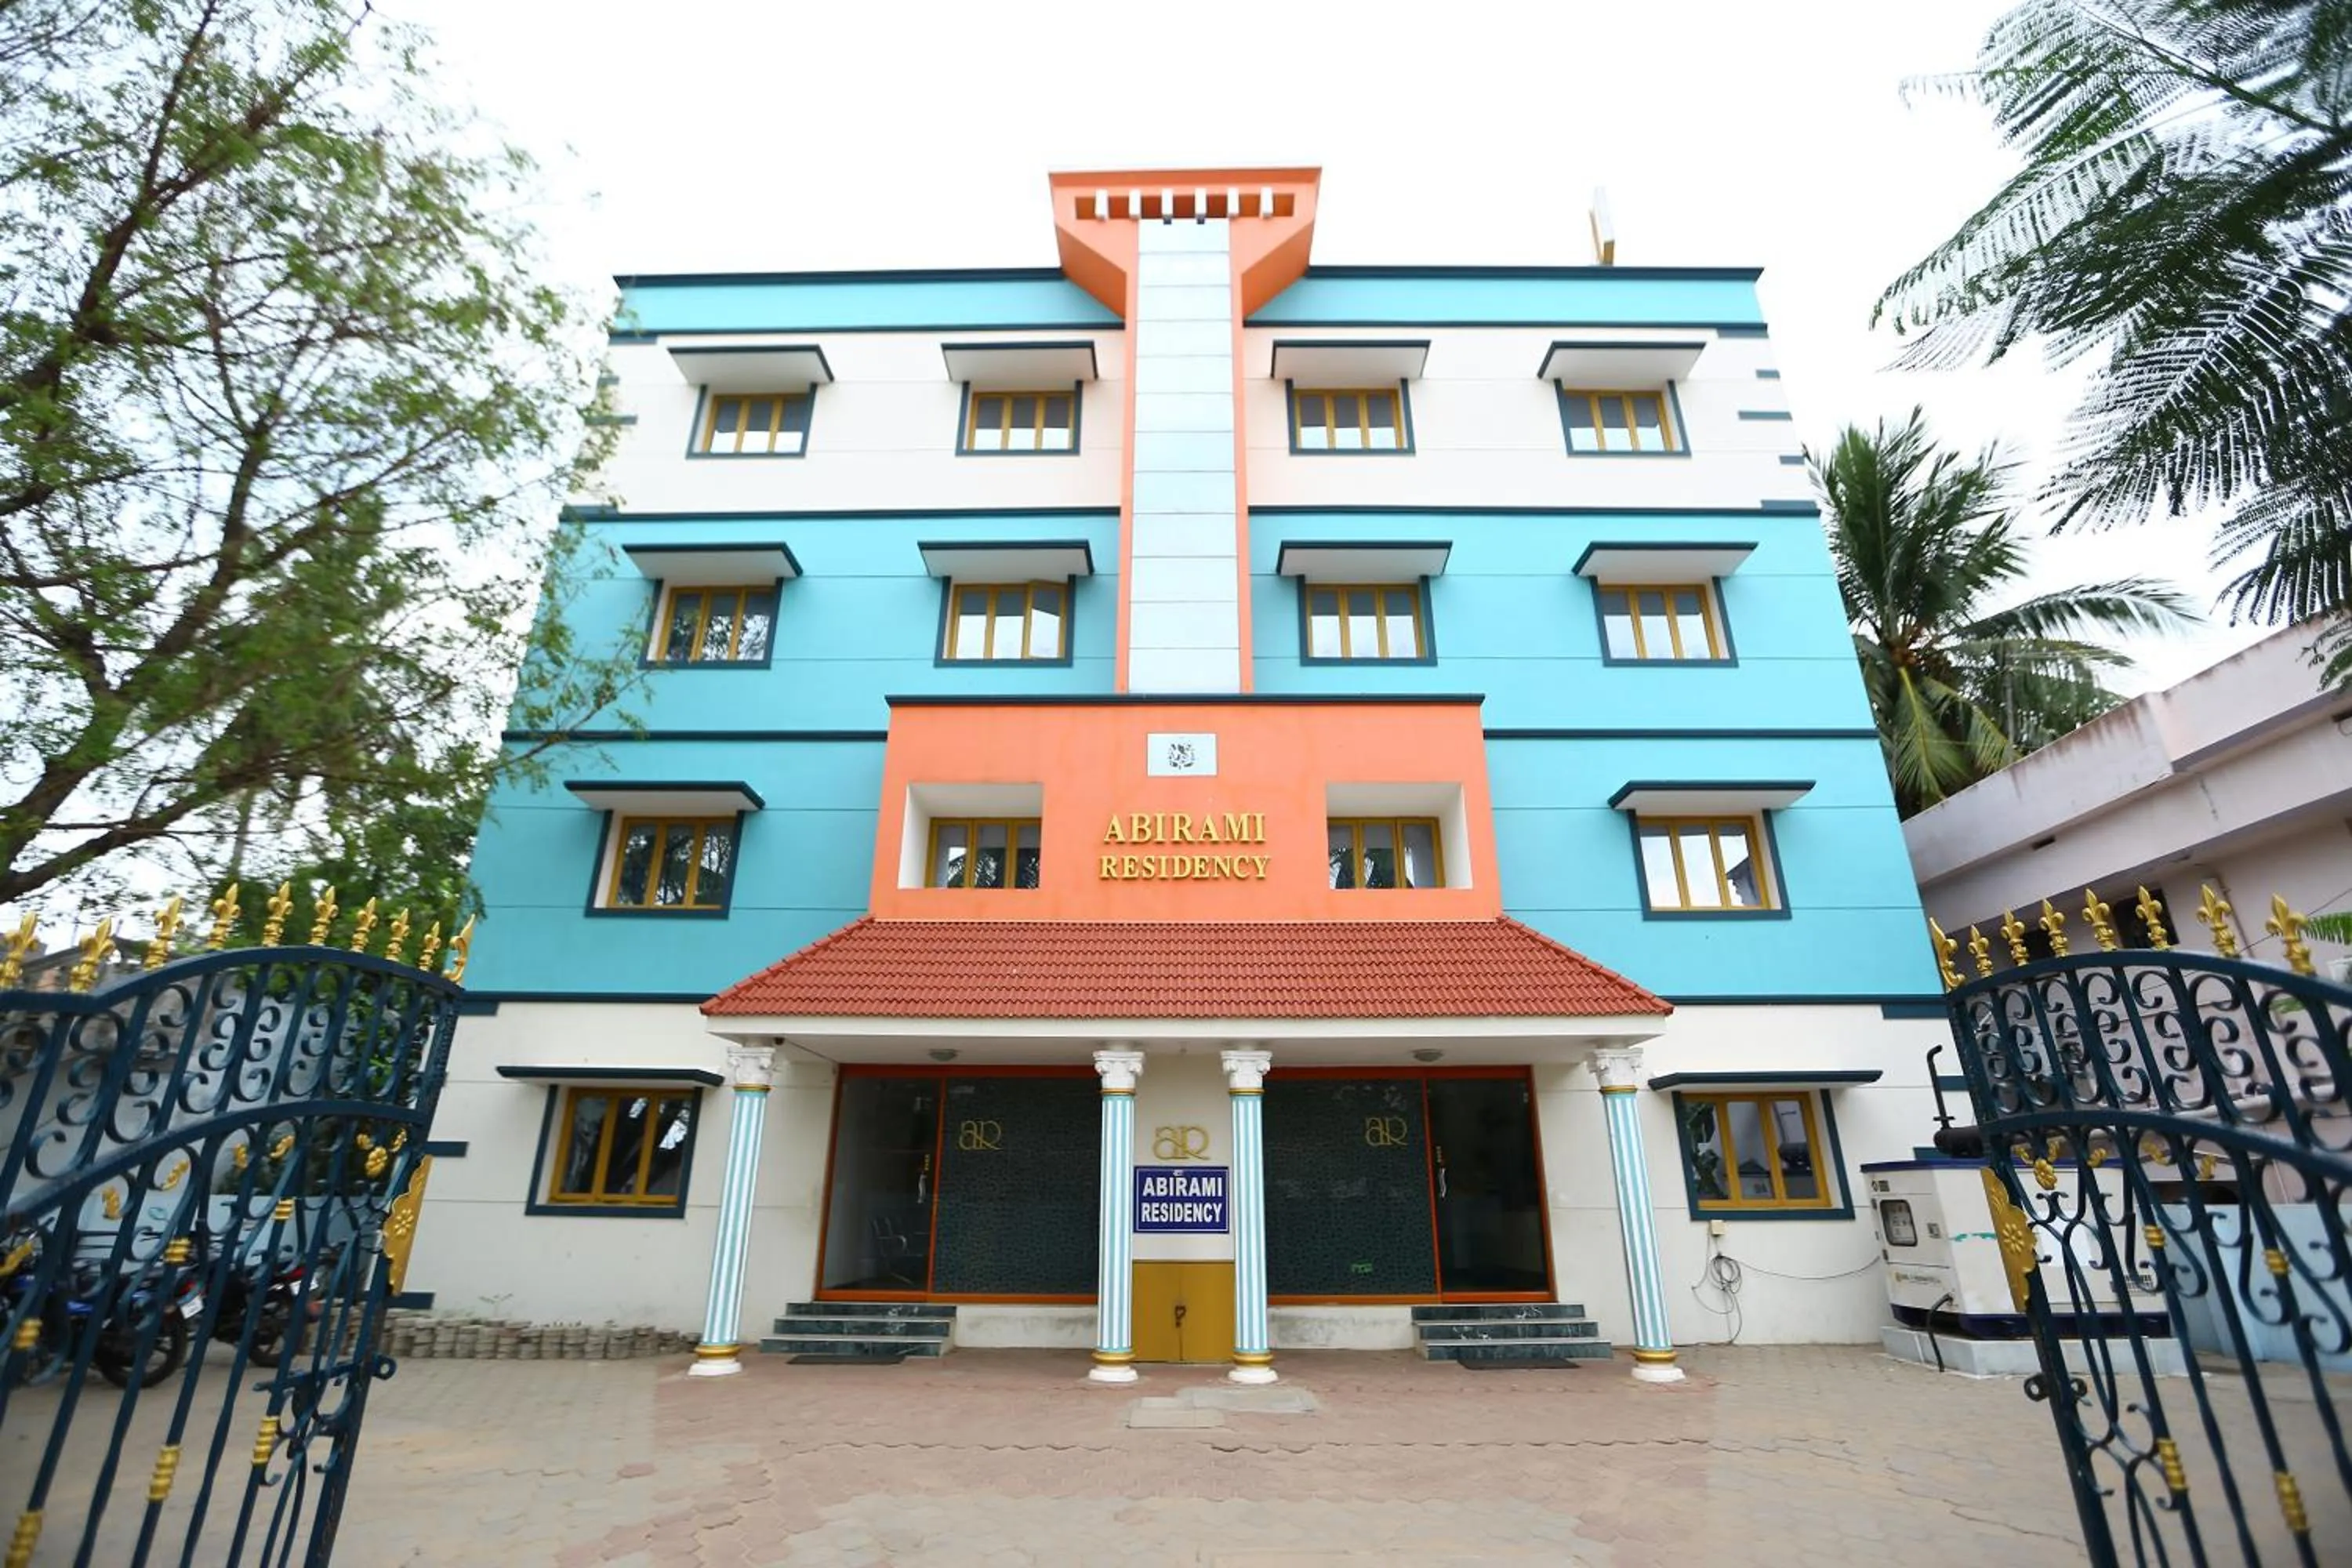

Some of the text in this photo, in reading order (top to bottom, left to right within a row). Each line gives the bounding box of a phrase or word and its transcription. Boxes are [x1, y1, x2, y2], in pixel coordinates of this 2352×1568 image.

[1103, 812, 1267, 844] ABIRAMI
[1099, 855, 1271, 880] RESIDENCY
[1142, 1177, 1222, 1196] ABIRAMI
[1141, 1202, 1222, 1222] RESIDENCY
